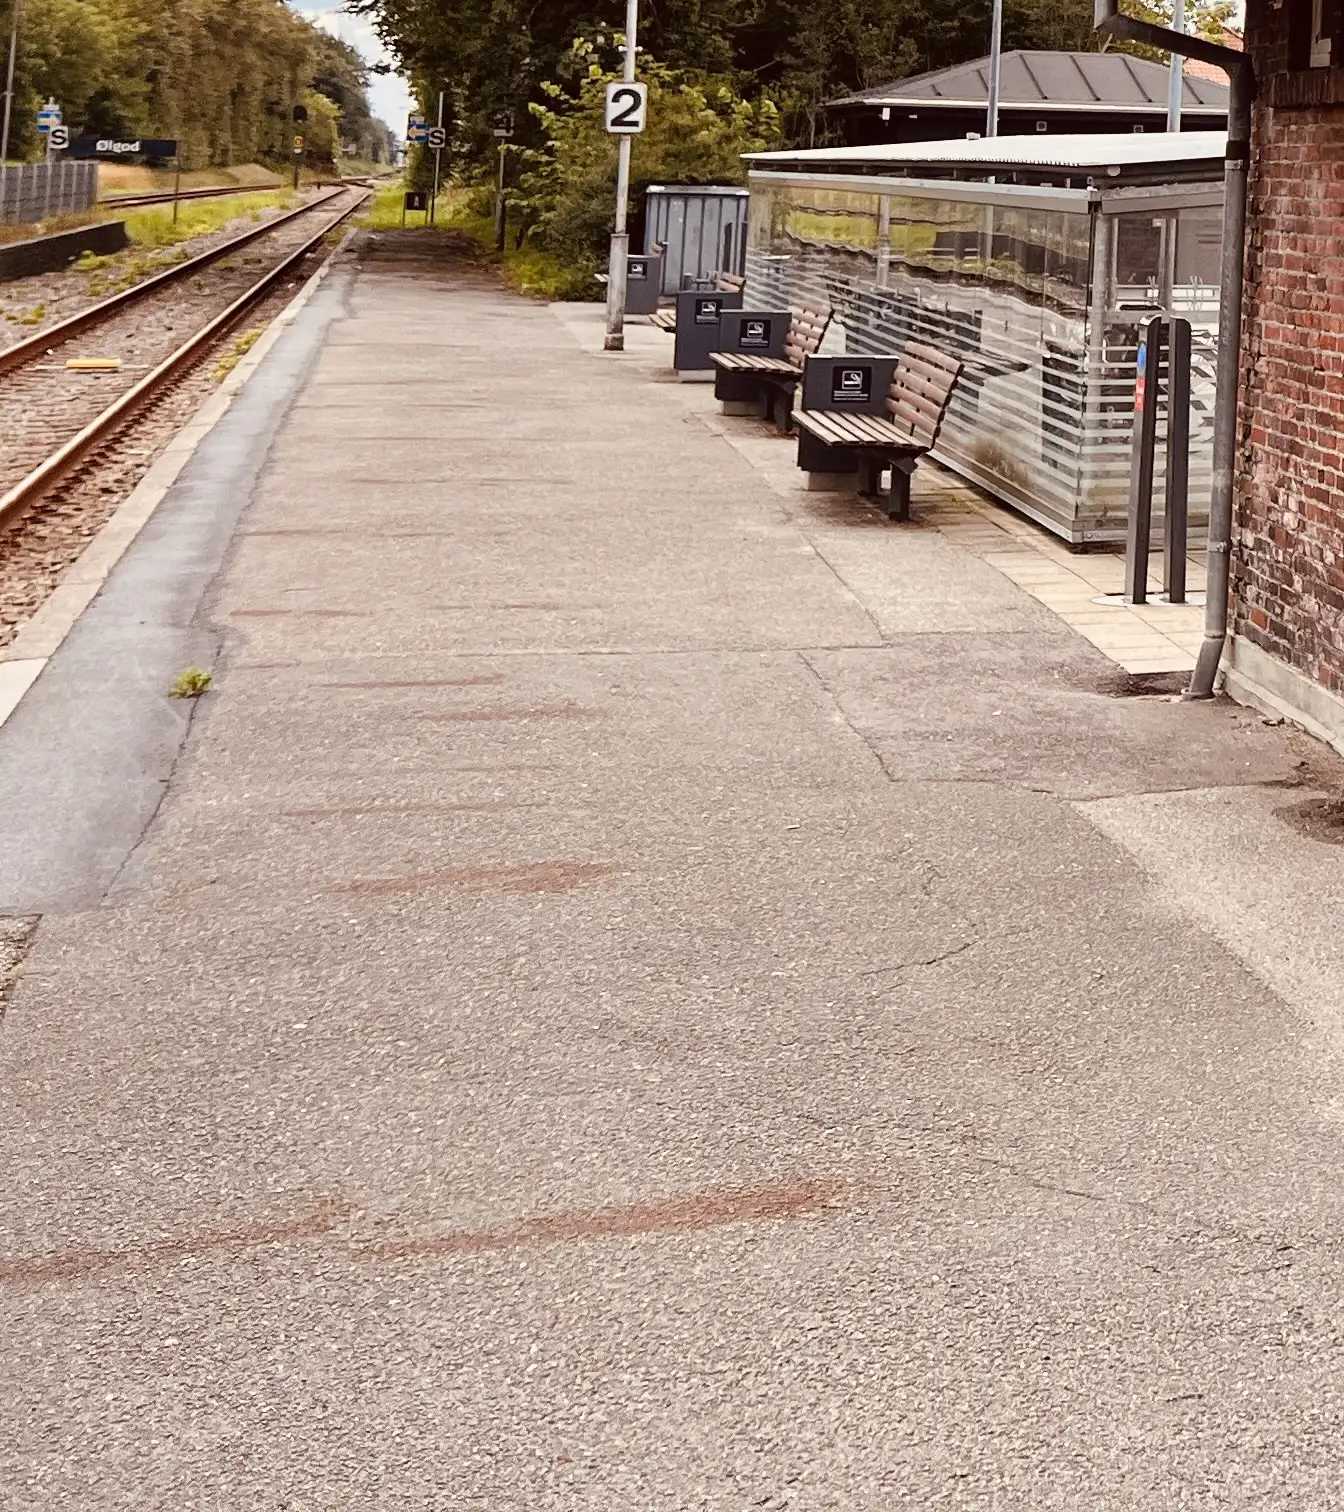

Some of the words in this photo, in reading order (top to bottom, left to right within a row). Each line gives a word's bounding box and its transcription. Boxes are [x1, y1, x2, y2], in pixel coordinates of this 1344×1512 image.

[610, 88, 642, 127] 2
[51, 128, 67, 145] S
[429, 129, 444, 146] S
[95, 139, 141, 153] Ølgod
